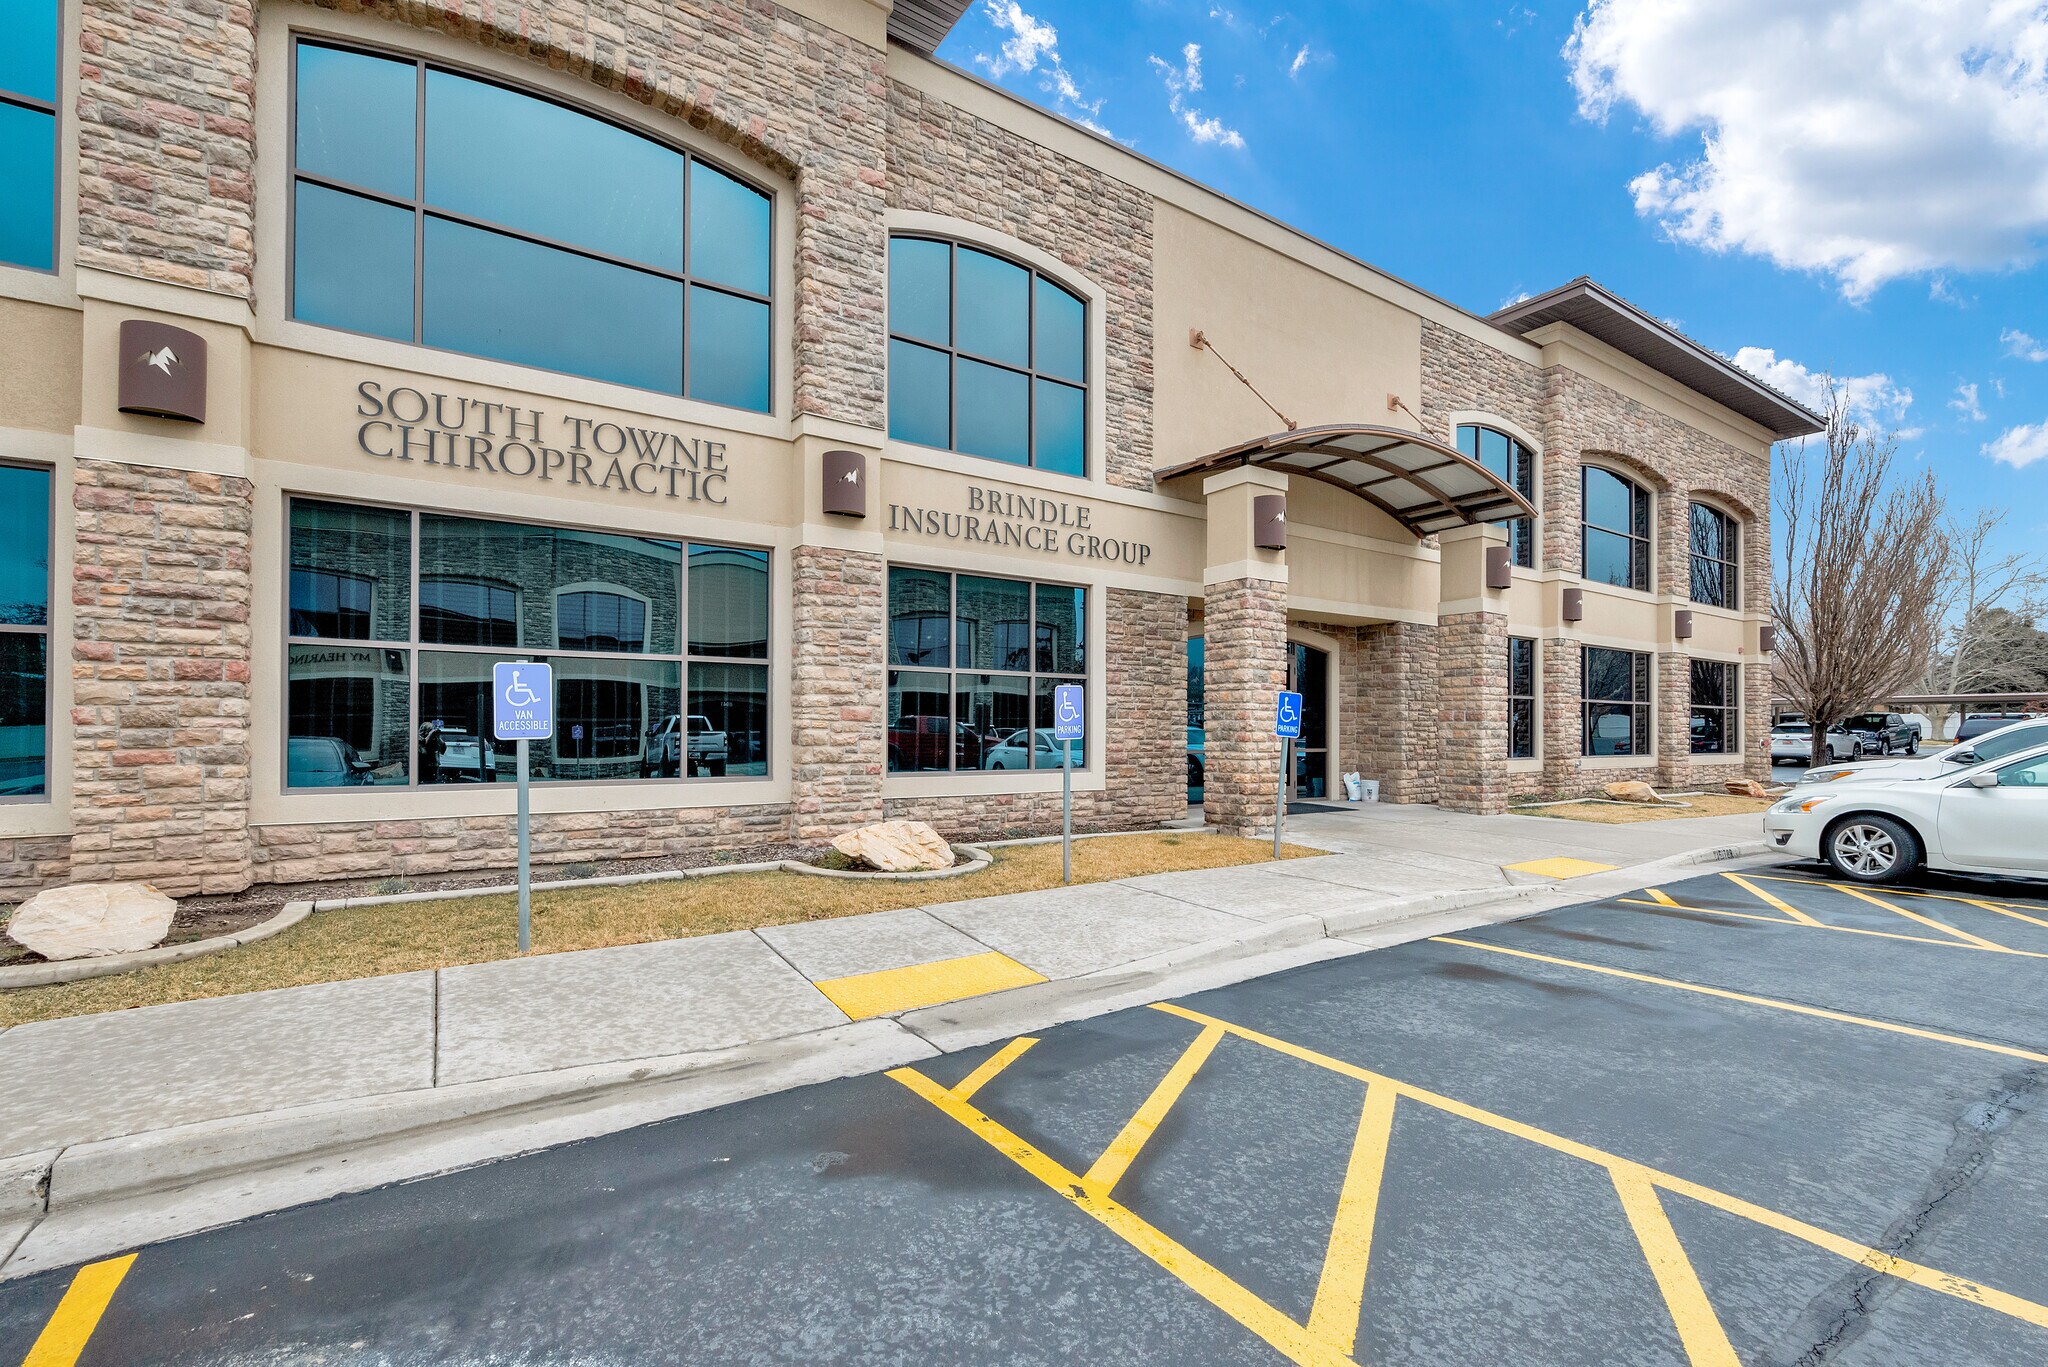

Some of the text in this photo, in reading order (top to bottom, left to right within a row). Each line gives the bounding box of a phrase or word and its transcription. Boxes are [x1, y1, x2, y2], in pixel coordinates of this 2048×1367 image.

[357, 380, 729, 473] SOUTH TOWNE
[357, 420, 728, 504] CHIROPRACTIC
[968, 486, 1092, 530] BRINDLE
[888, 503, 1151, 566] INSURANCE GROUP
[498, 720, 549, 731] ACCESSIBLE
[514, 710, 533, 720] VAN
[1057, 725, 1082, 735] PARKING
[1277, 724, 1298, 734] PARKING
